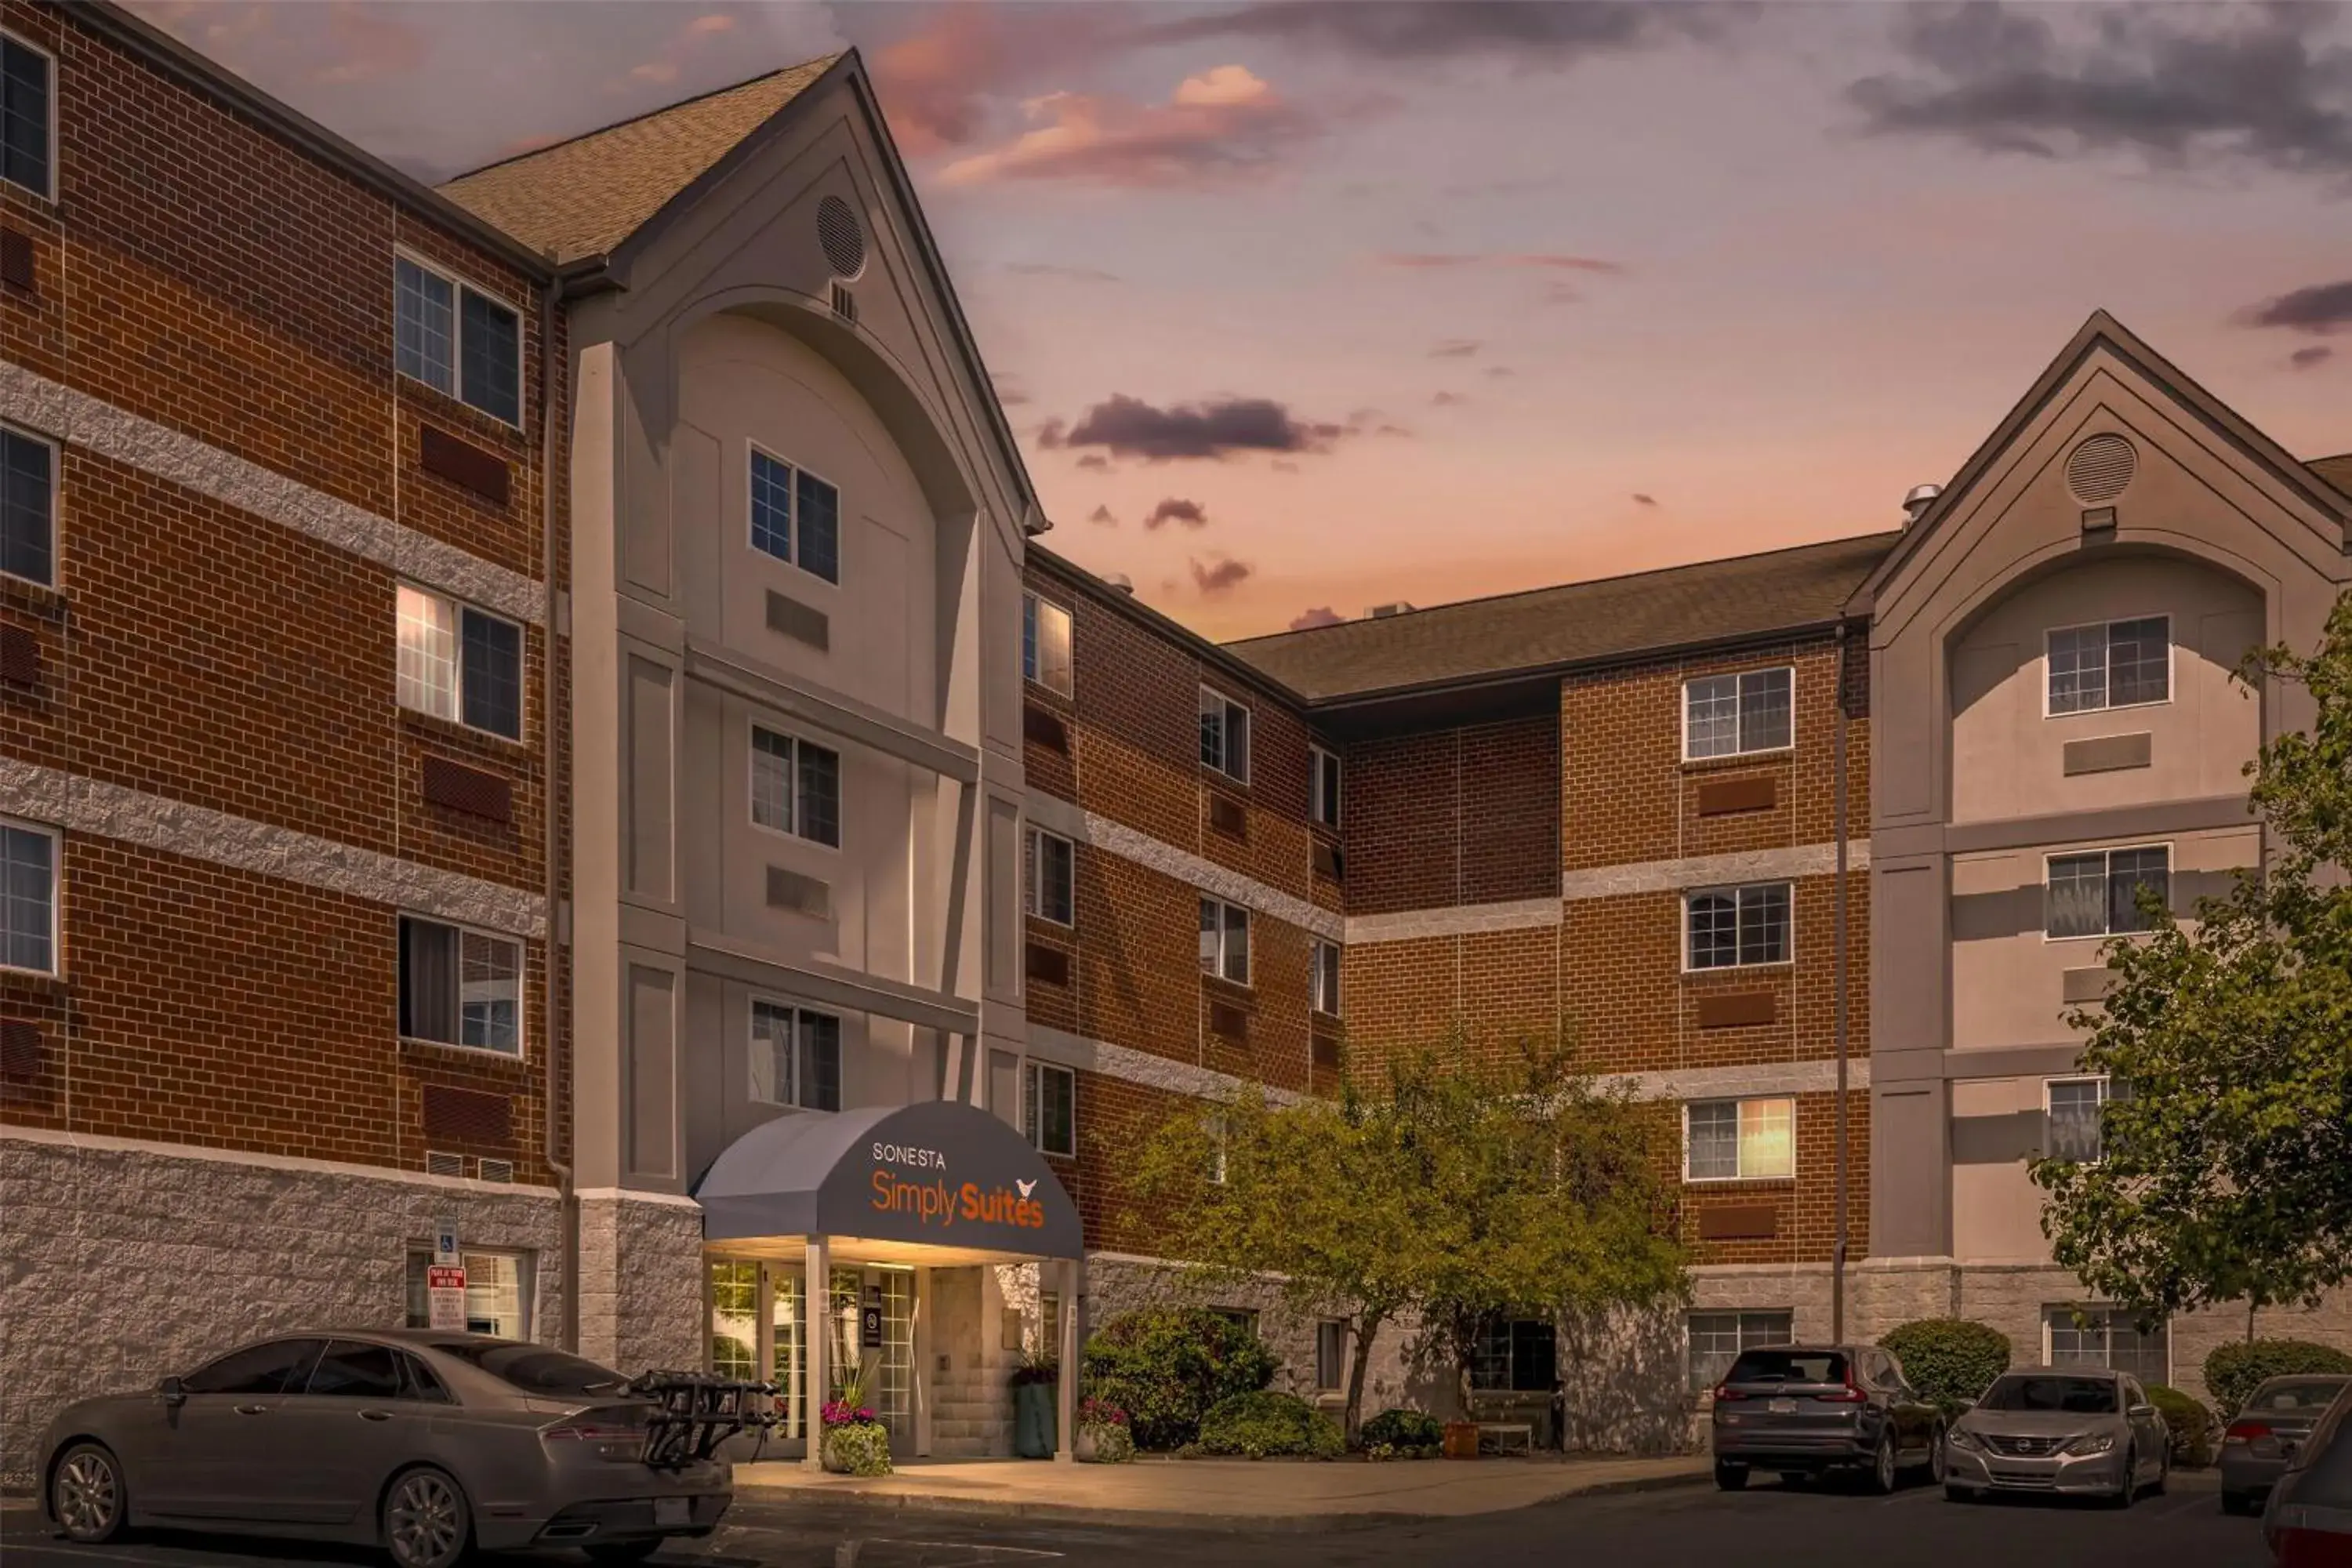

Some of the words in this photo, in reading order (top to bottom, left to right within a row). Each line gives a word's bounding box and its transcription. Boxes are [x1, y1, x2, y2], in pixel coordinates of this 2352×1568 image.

[873, 1142, 946, 1171] SONESTA
[872, 1171, 957, 1227] Simply
[961, 1182, 1044, 1229] Suites
